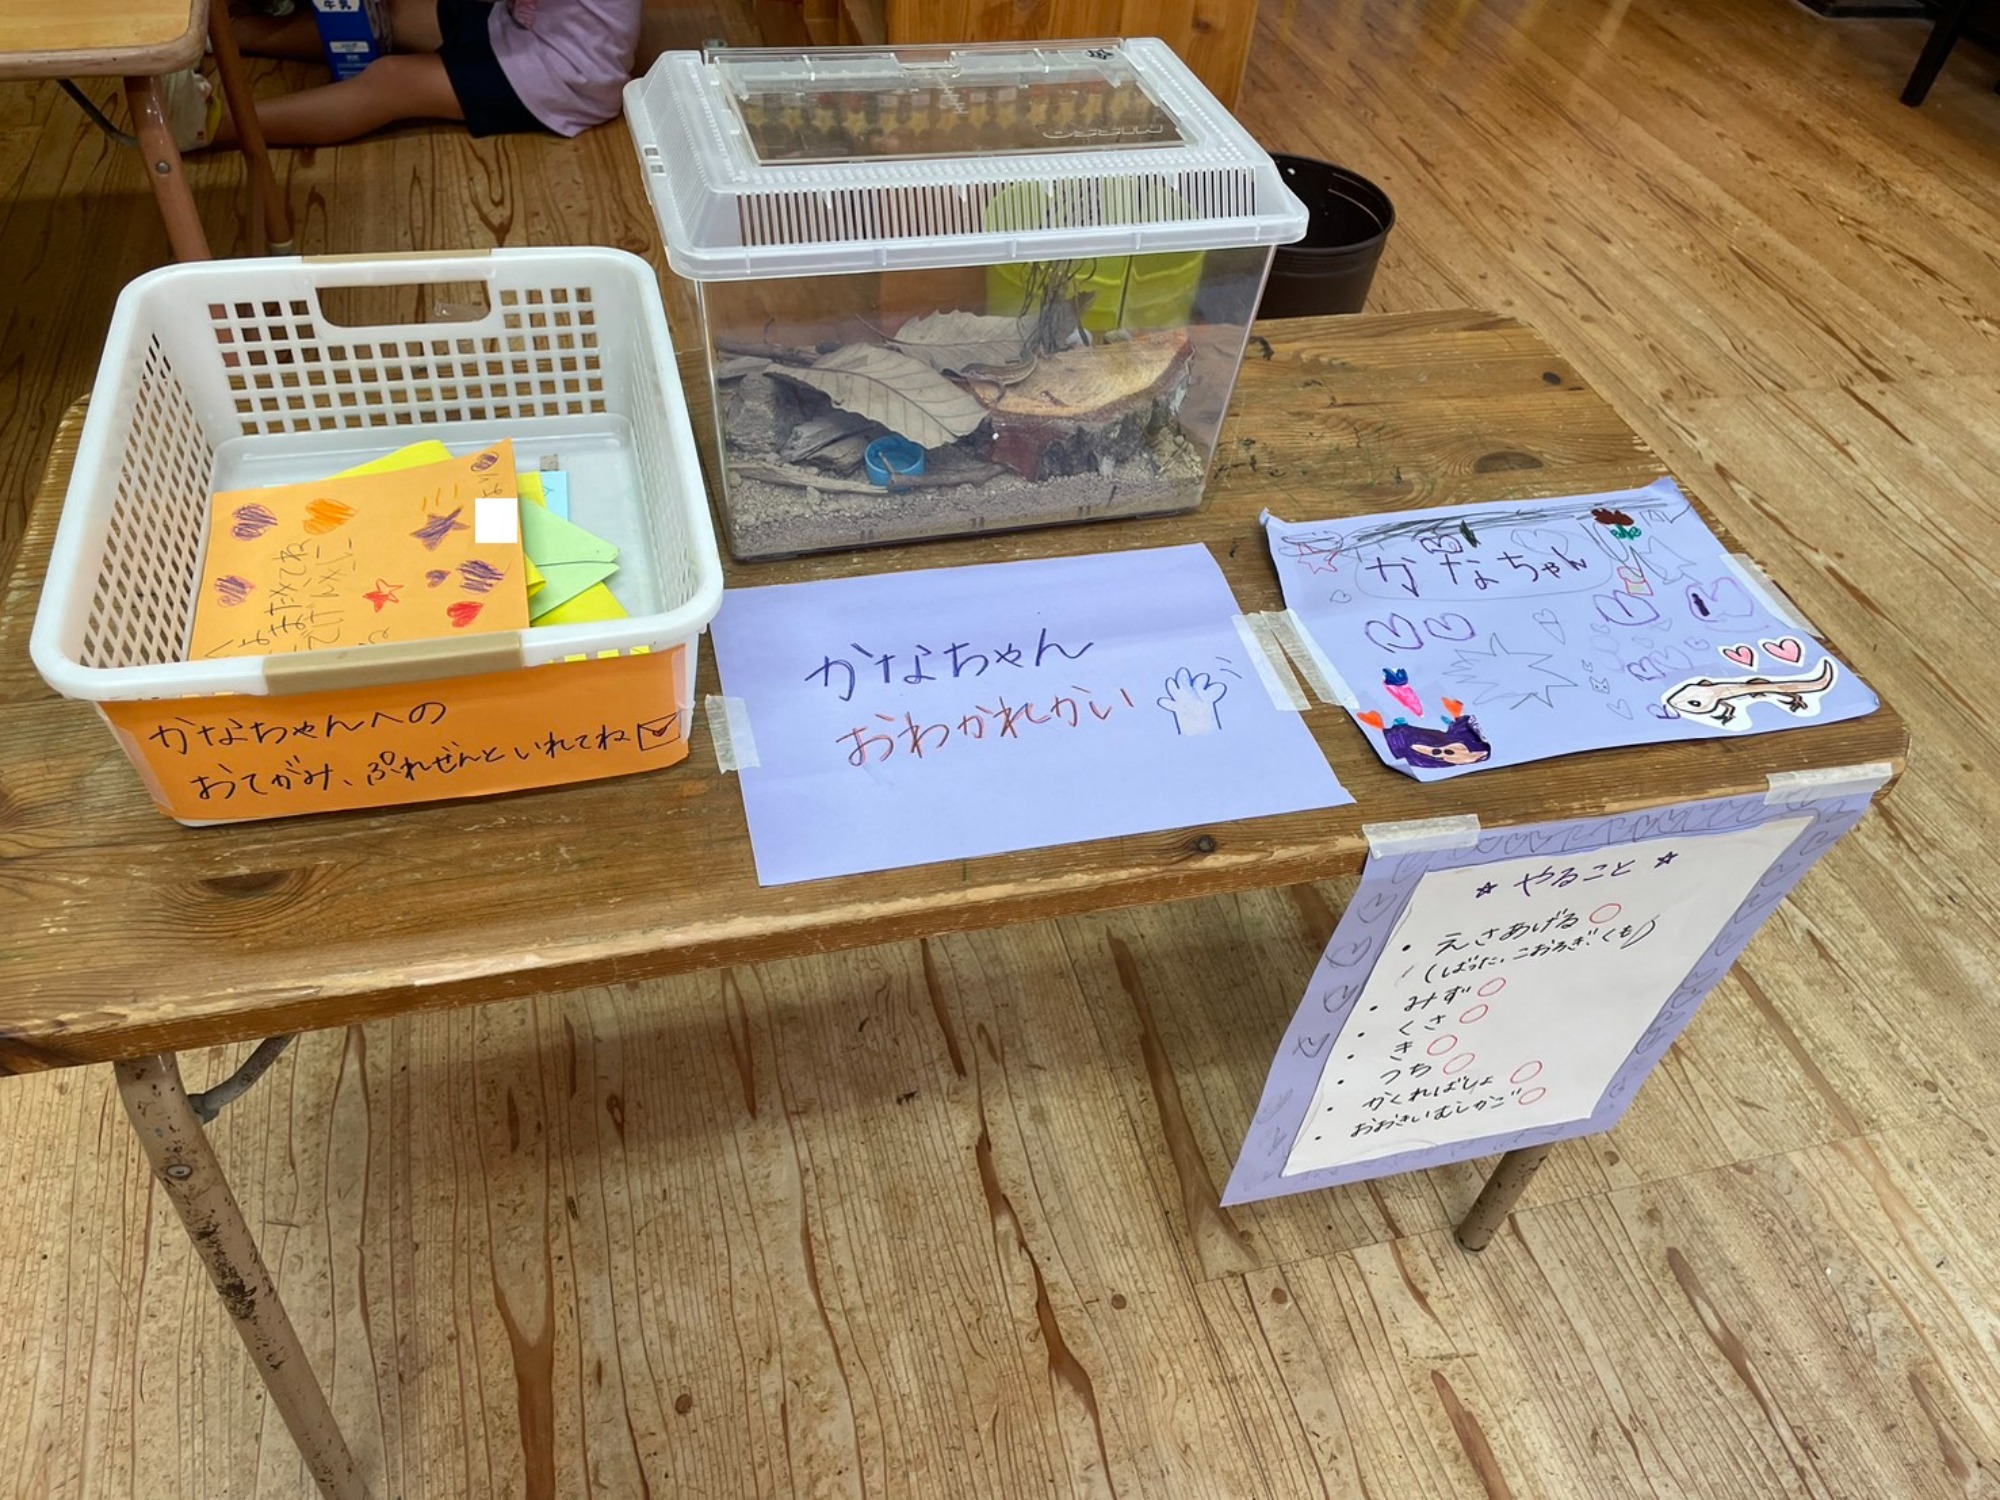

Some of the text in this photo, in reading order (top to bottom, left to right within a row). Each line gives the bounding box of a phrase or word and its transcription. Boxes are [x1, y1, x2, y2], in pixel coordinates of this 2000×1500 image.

[1364, 546, 1588, 598] かなちゃん
[804, 627, 1094, 702] かなちゃん
[149, 701, 447, 755] かなちゃんへの
[835, 685, 1134, 767] おわかれかい
[1513, 859, 1636, 897] やること
